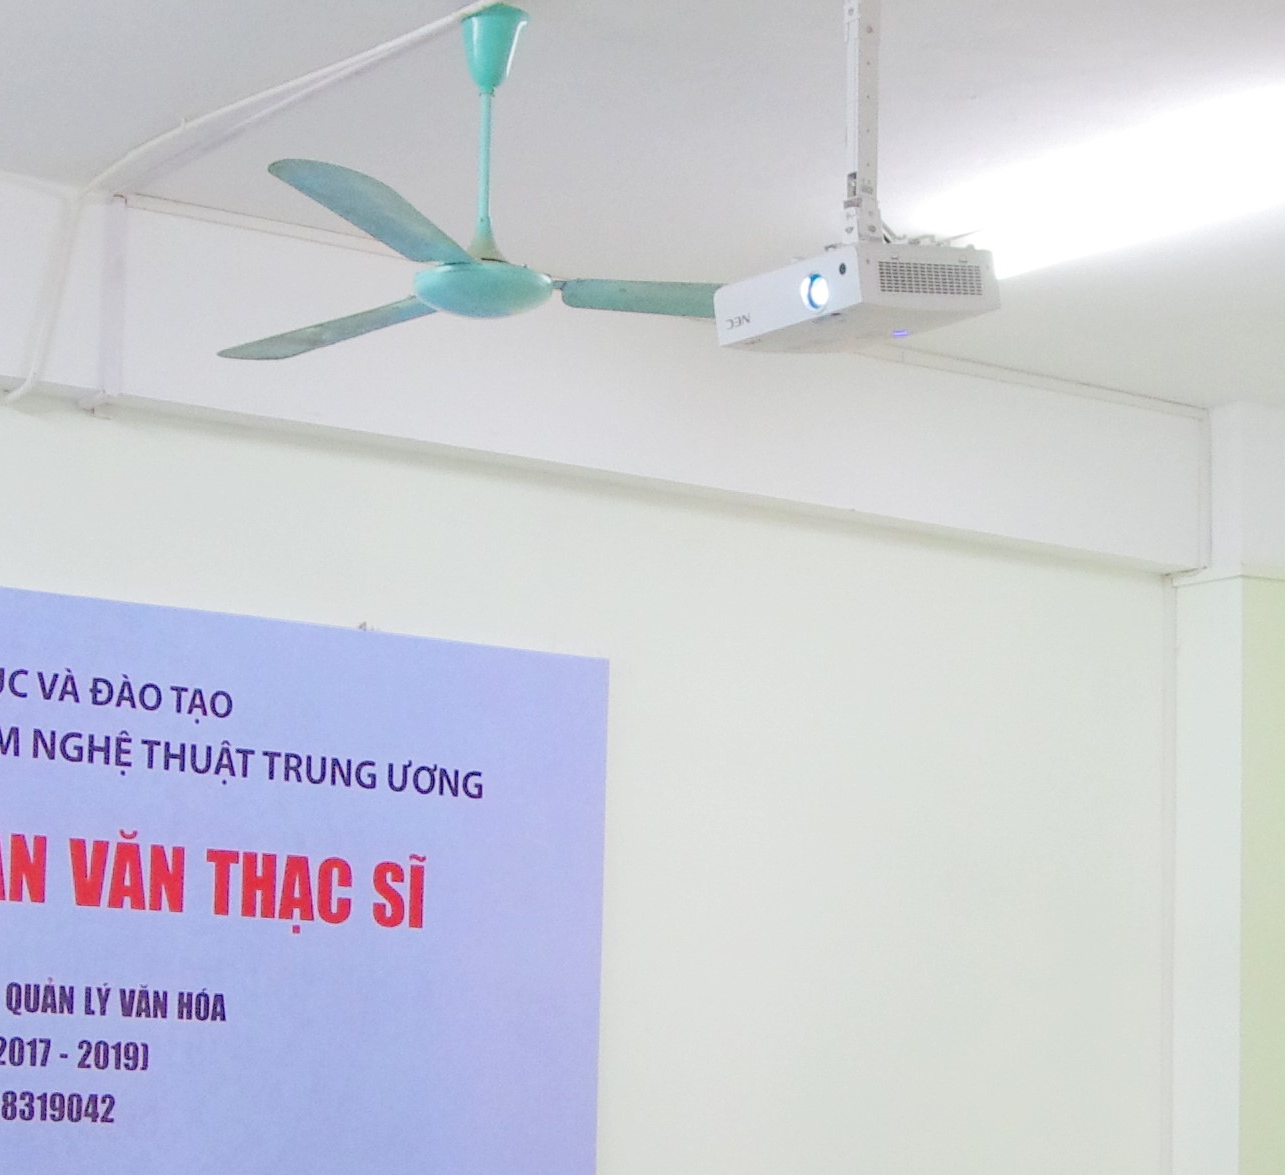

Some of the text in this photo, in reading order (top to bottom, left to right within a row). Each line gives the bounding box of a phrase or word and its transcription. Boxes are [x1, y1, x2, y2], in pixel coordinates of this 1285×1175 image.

[36, 667, 80, 704] VÀ
[88, 673, 163, 712] ĐÀO
[169, 685, 233, 725] TẠO
[32, 728, 133, 777] NGHỆ
[140, 738, 256, 786] THUẬT
[262, 750, 377, 790] TRUNG
[387, 759, 483, 800] ƯƠNG
[69, 831, 186, 913] VĂN
[206, 848, 353, 934] THẠC
[373, 854, 427, 929] SĨ
[5, 977, 75, 1016] QUẢN
[84, 983, 112, 1017] LÝ
[119, 985, 168, 1019] VĂN
[177, 987, 227, 1022] HÓA
[77, 1039, 149, 1071] 2019)
[1, 1090, 116, 1124] 8319042
